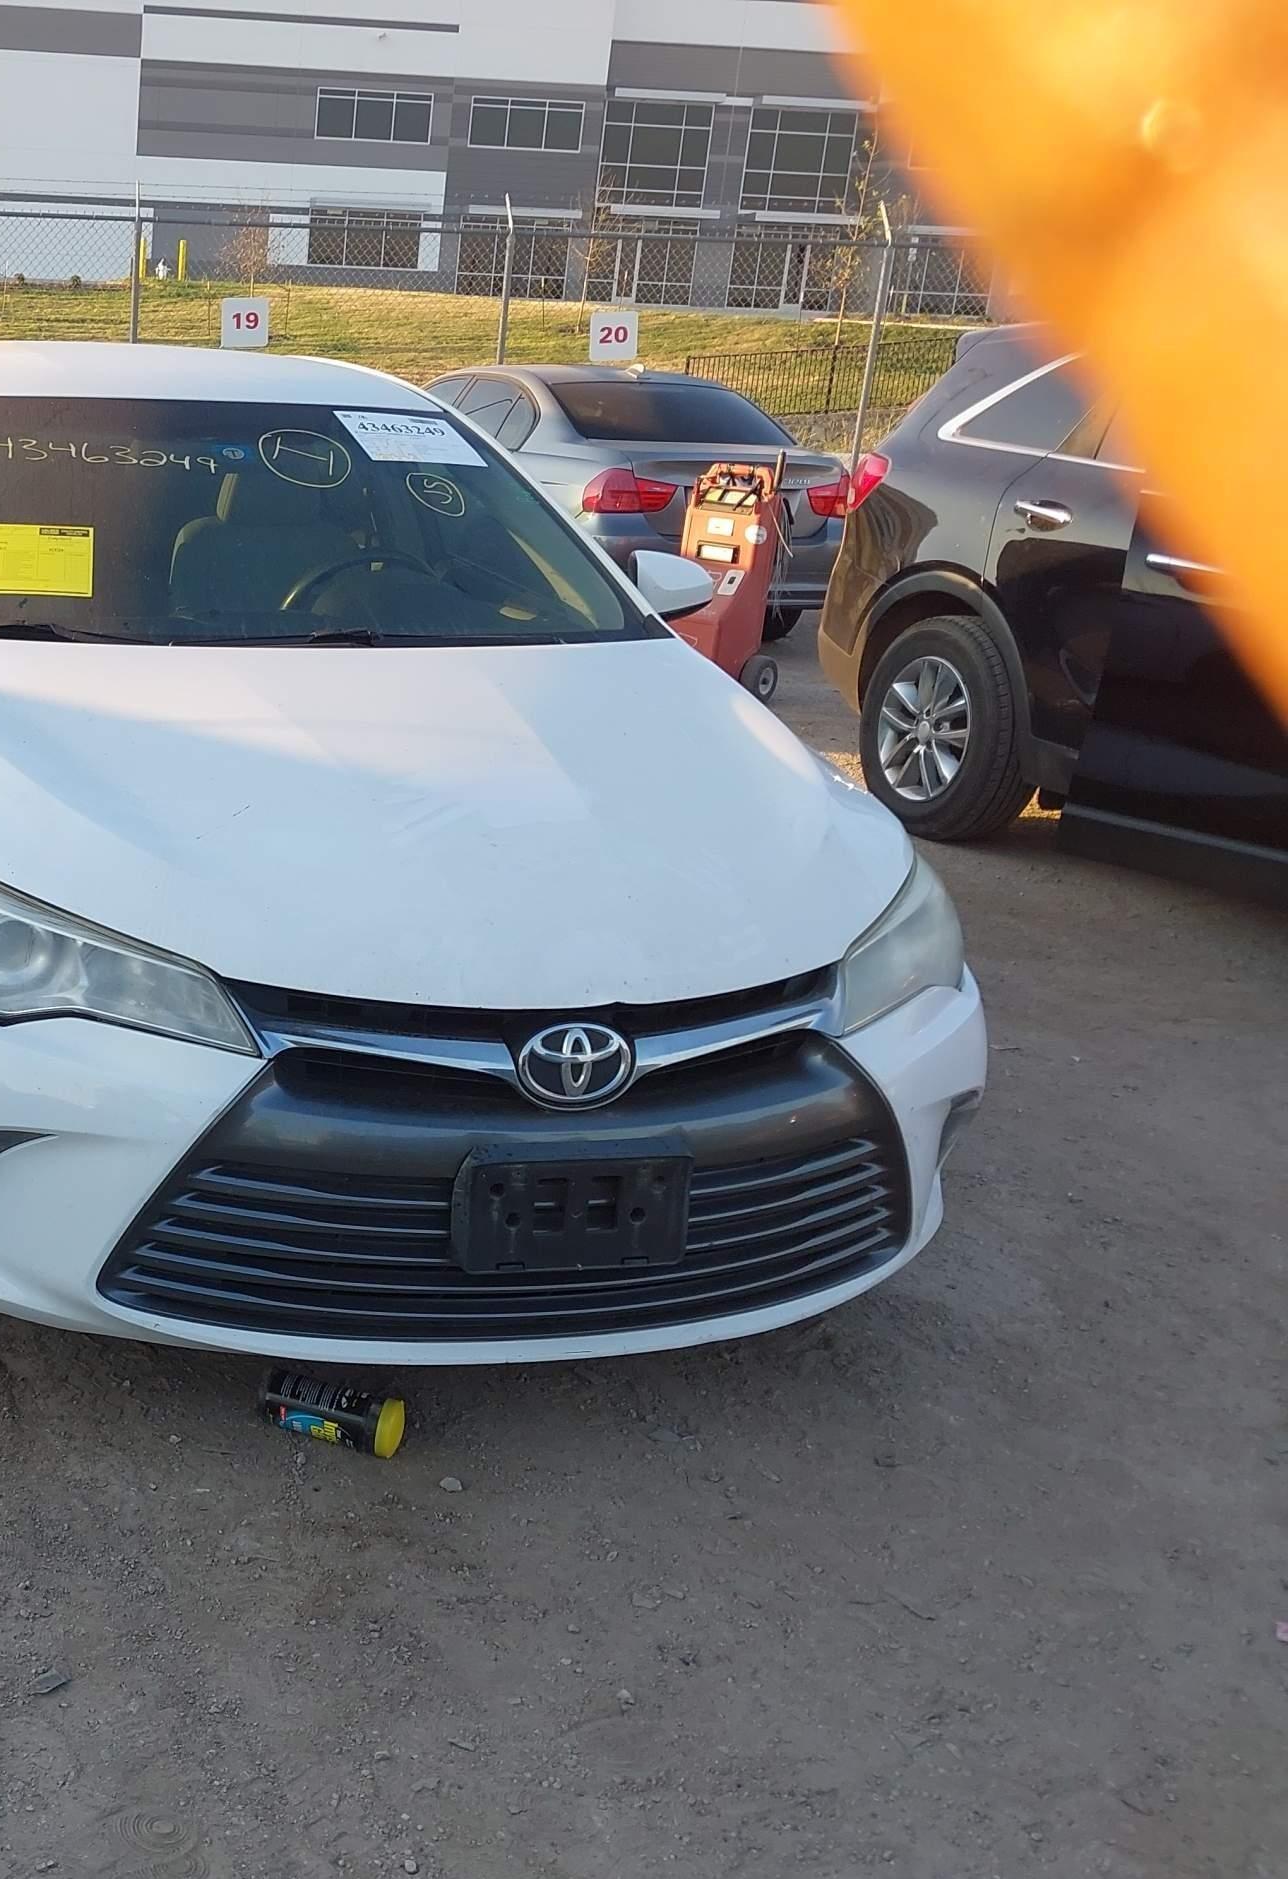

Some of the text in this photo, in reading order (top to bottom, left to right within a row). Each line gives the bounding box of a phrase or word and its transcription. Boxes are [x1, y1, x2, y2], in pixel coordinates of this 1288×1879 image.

[231, 311, 260, 330] 19
[599, 326, 629, 344] 20
[357, 421, 446, 437] 43463249
